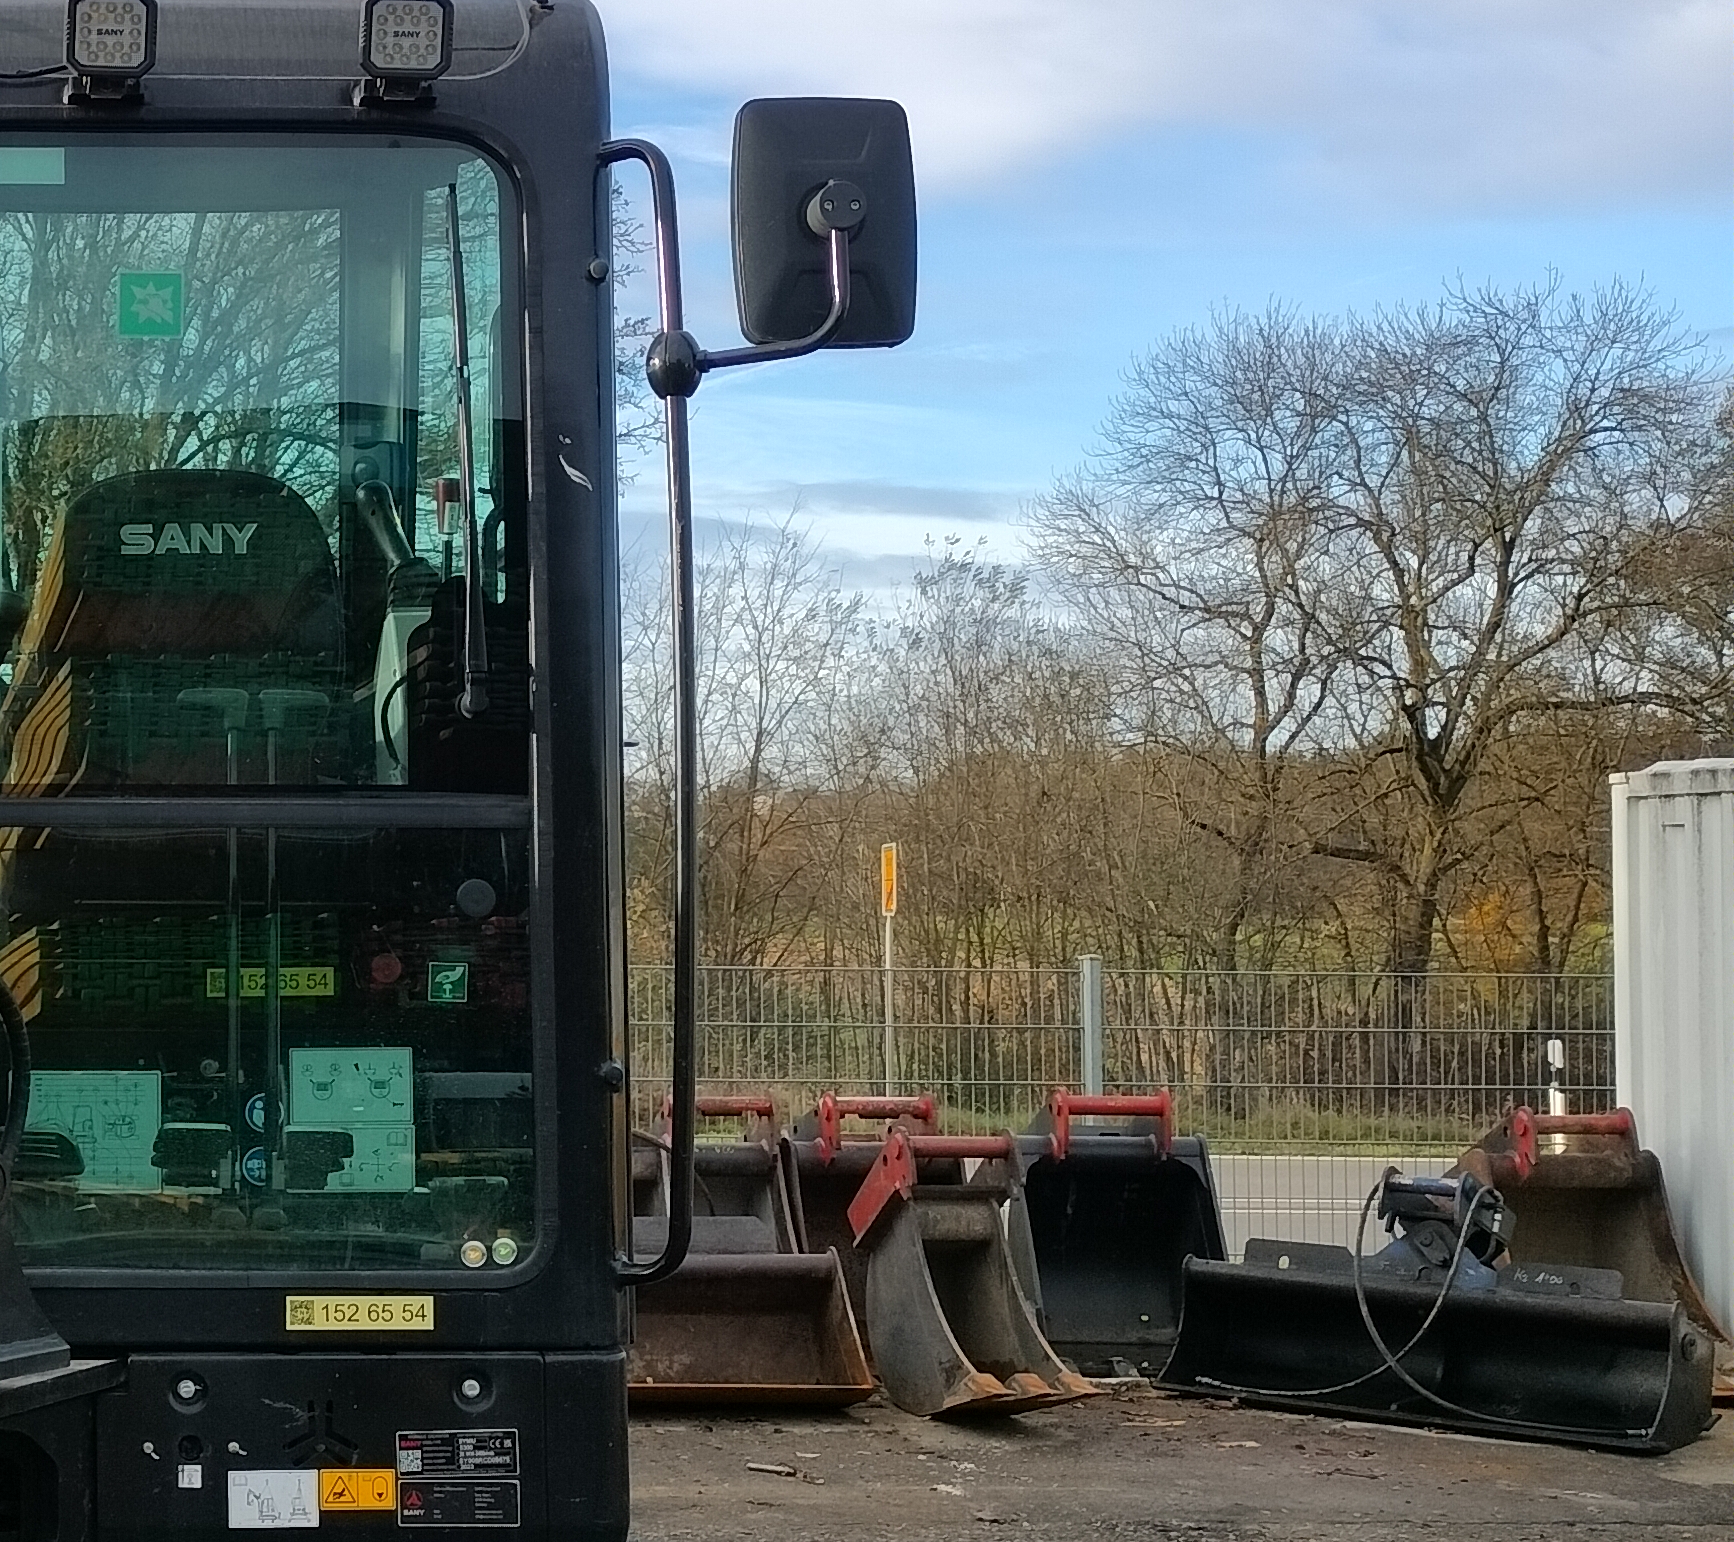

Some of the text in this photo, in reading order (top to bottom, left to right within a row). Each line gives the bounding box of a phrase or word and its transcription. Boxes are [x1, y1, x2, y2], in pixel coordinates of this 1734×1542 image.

[96, 28, 125, 37] SANY
[392, 30, 421, 39] SANY
[119, 522, 259, 555] SANY
[278, 973, 300, 990] 65
[306, 971, 329, 990] 54
[321, 1302, 428, 1323] 152 65 54
